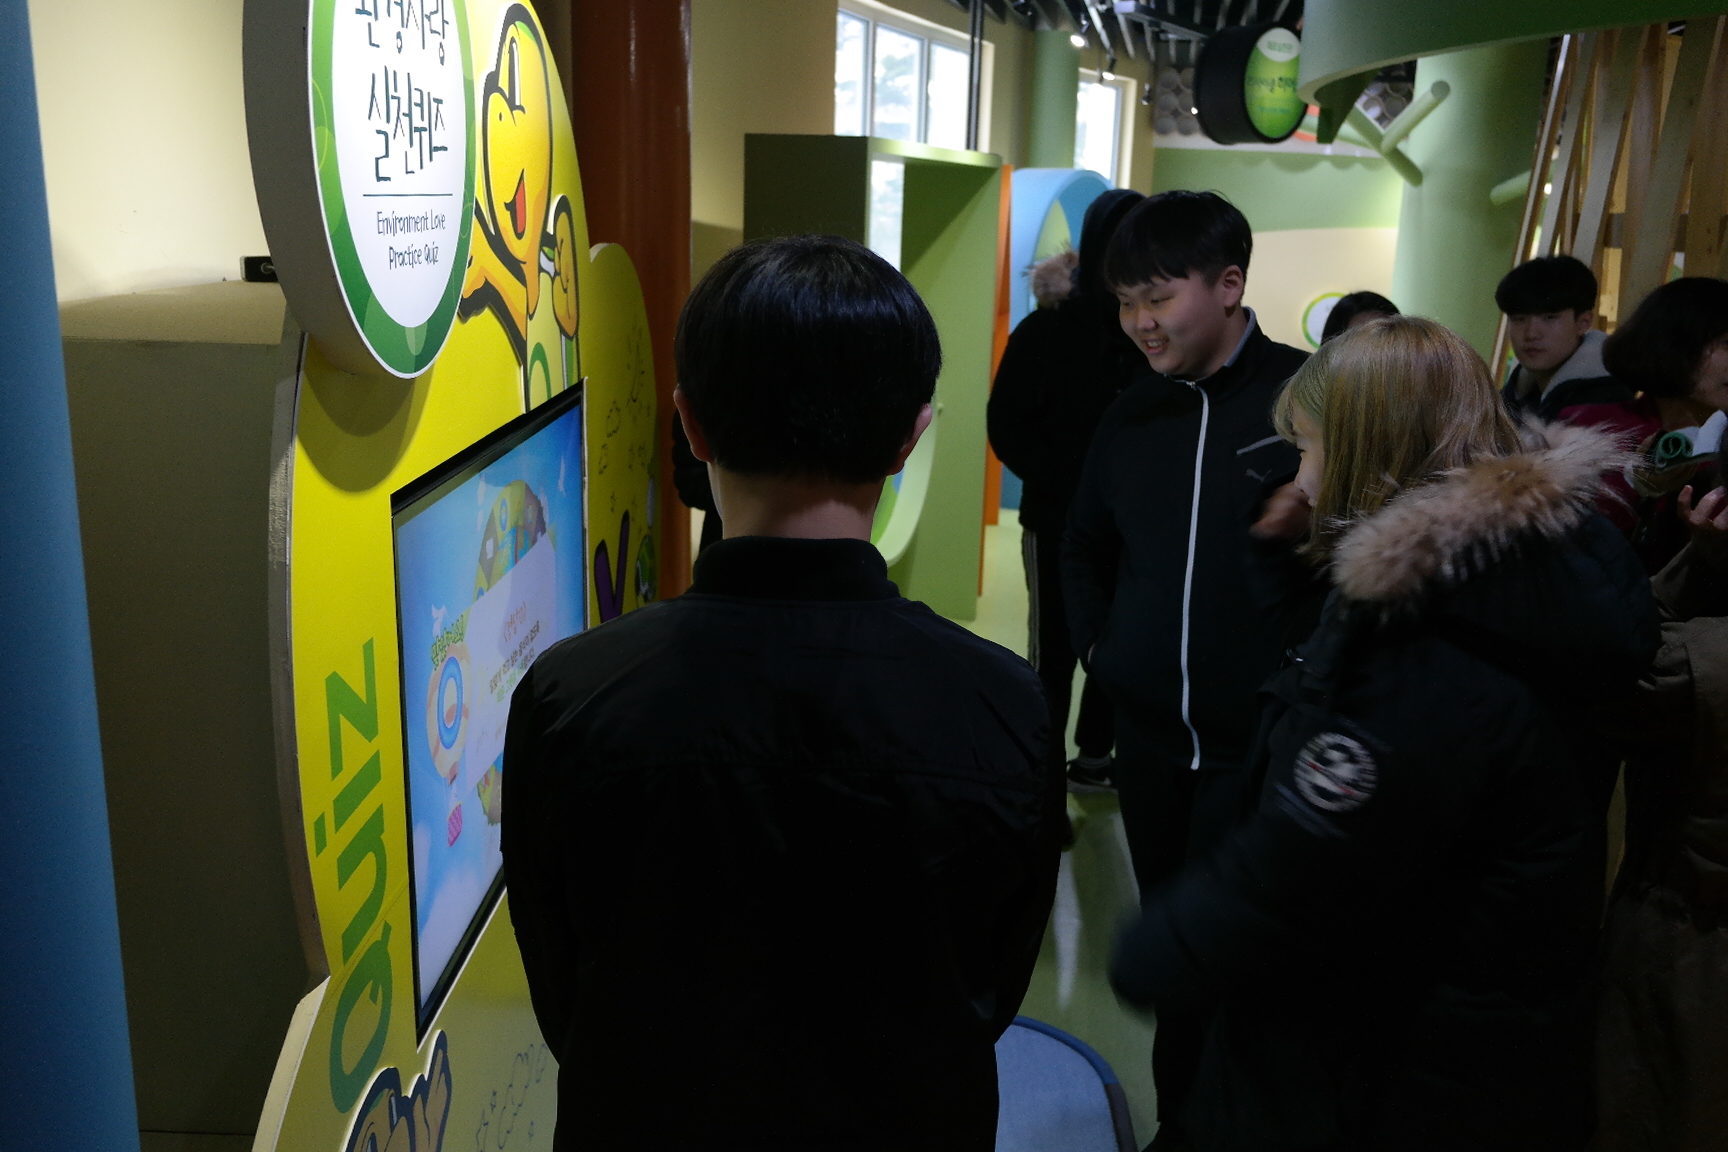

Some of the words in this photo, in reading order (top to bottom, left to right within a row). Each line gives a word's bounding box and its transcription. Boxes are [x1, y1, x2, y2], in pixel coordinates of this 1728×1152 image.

[368, 65, 448, 182] 실천퀴즈
[377, 211, 429, 236] Environment
[431, 209, 446, 230] Love
[388, 244, 422, 270] Practice
[424, 241, 439, 265] Quiz
[314, 637, 393, 1115] Quiz
